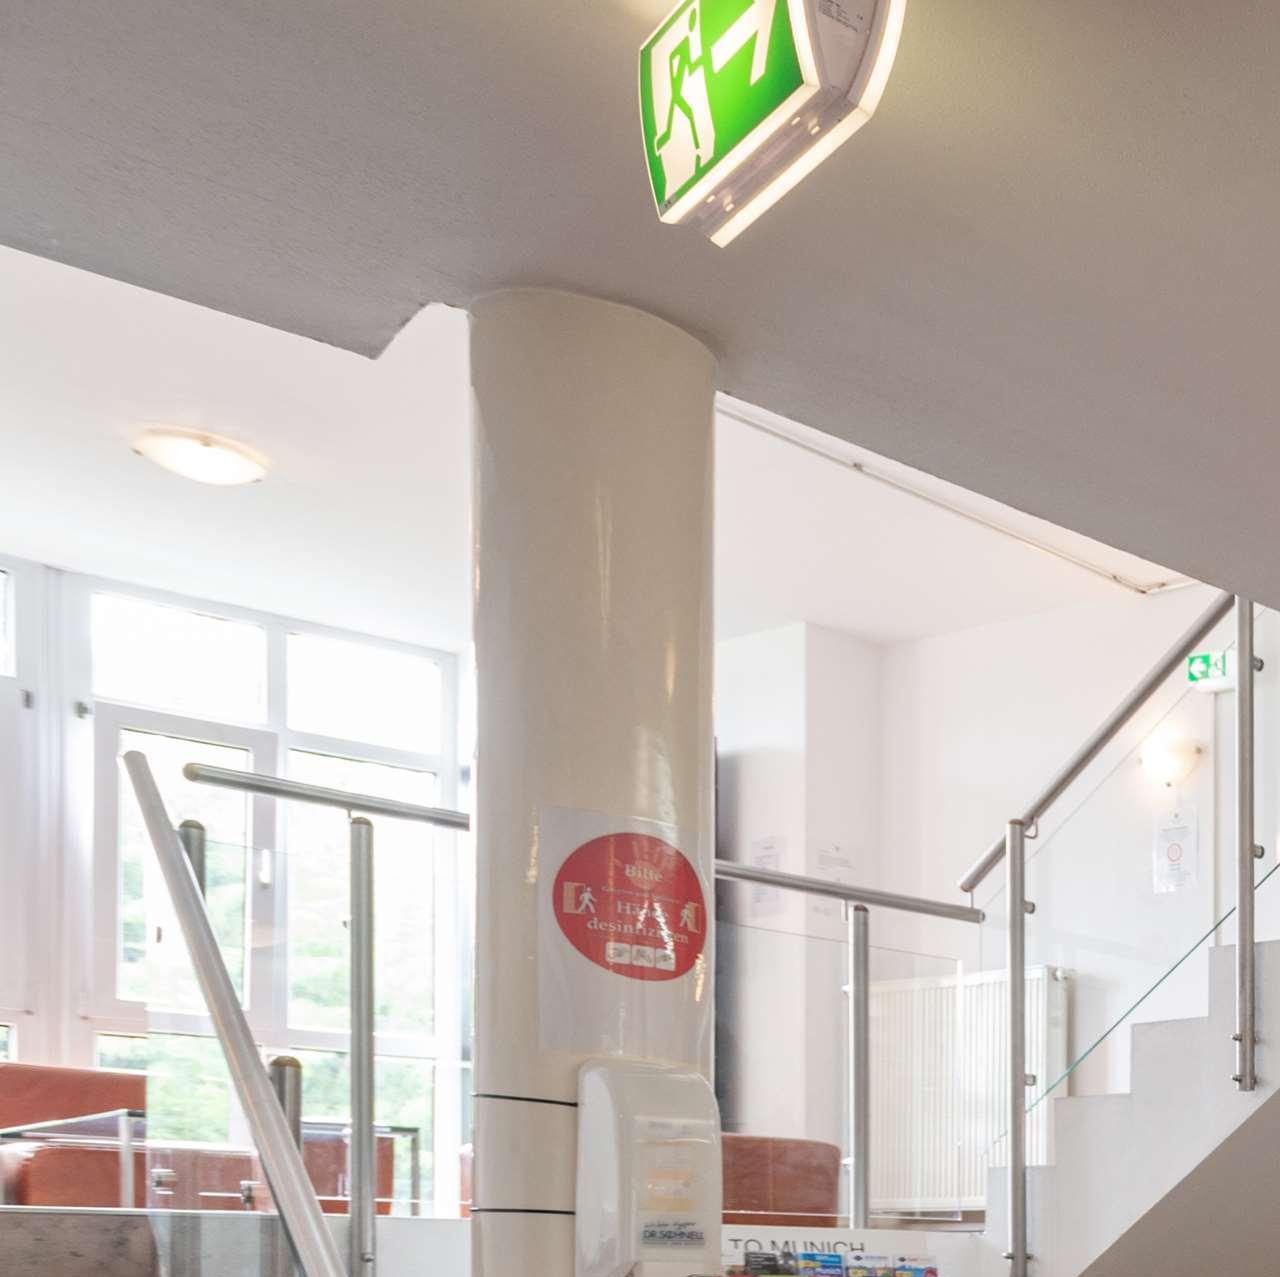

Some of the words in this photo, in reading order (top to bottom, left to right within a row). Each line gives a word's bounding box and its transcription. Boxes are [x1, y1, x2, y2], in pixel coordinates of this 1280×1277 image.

[625, 864, 663, 881] Bitte
[728, 1238, 762, 1253] TO
[770, 1239, 865, 1253] MUNICH
